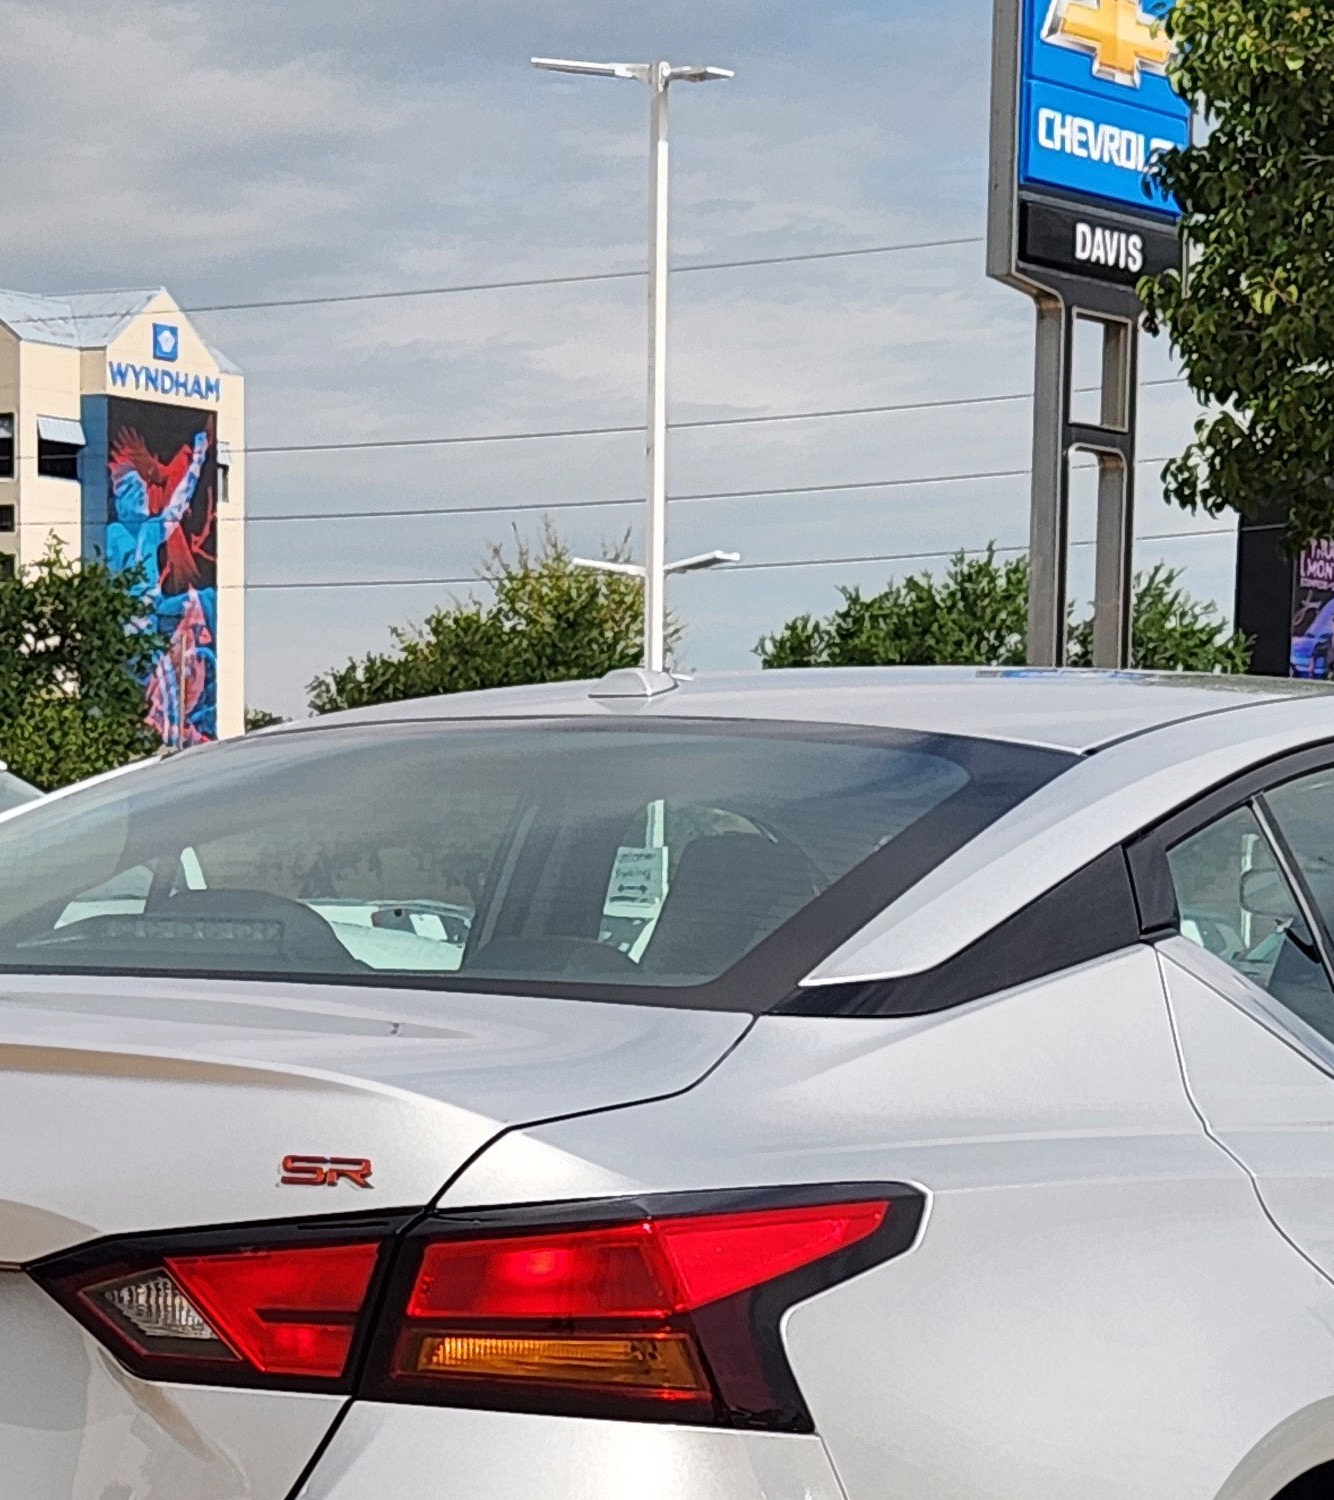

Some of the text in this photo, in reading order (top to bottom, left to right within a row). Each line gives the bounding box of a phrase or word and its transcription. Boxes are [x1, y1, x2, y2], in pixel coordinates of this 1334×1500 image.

[1038, 107, 1186, 173] CHEVROL
[1075, 222, 1143, 272] DAVIS
[108, 360, 221, 403] WYNDHAM
[280, 1154, 375, 1190] SR
